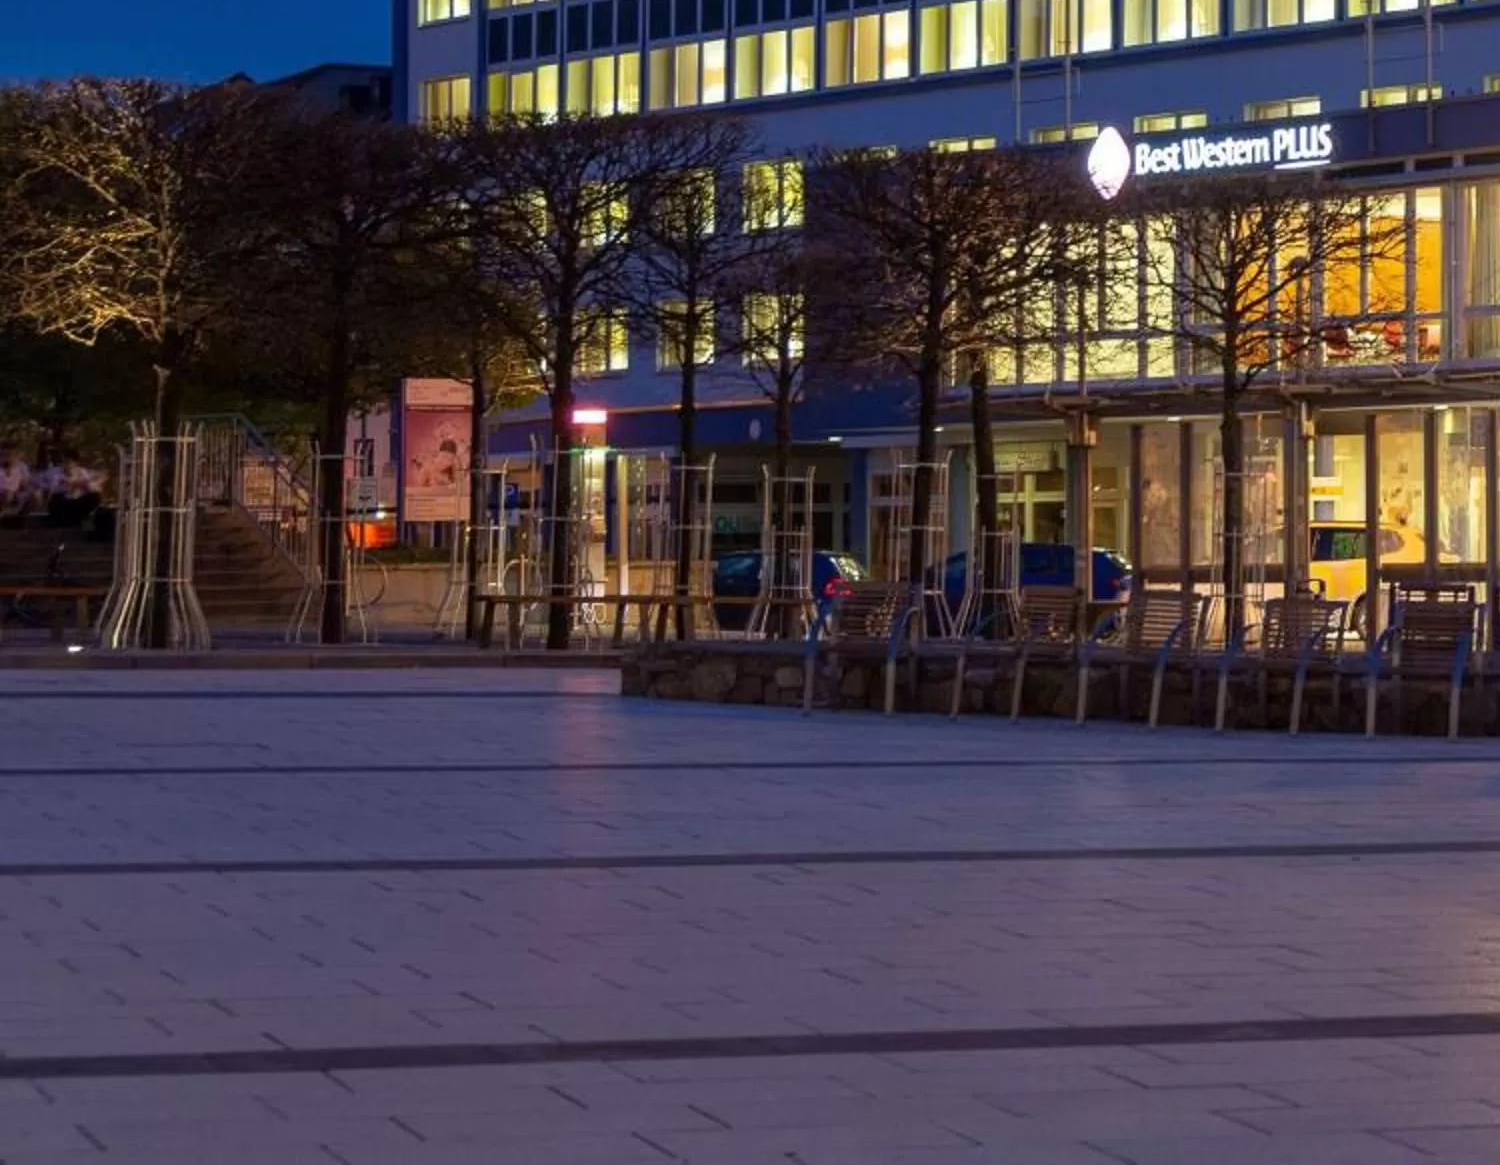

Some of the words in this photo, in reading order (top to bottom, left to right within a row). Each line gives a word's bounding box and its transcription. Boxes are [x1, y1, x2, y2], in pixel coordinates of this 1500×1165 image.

[1135, 142, 1182, 176] Best
[1182, 135, 1271, 170] Western
[1273, 124, 1332, 161] PLUS
